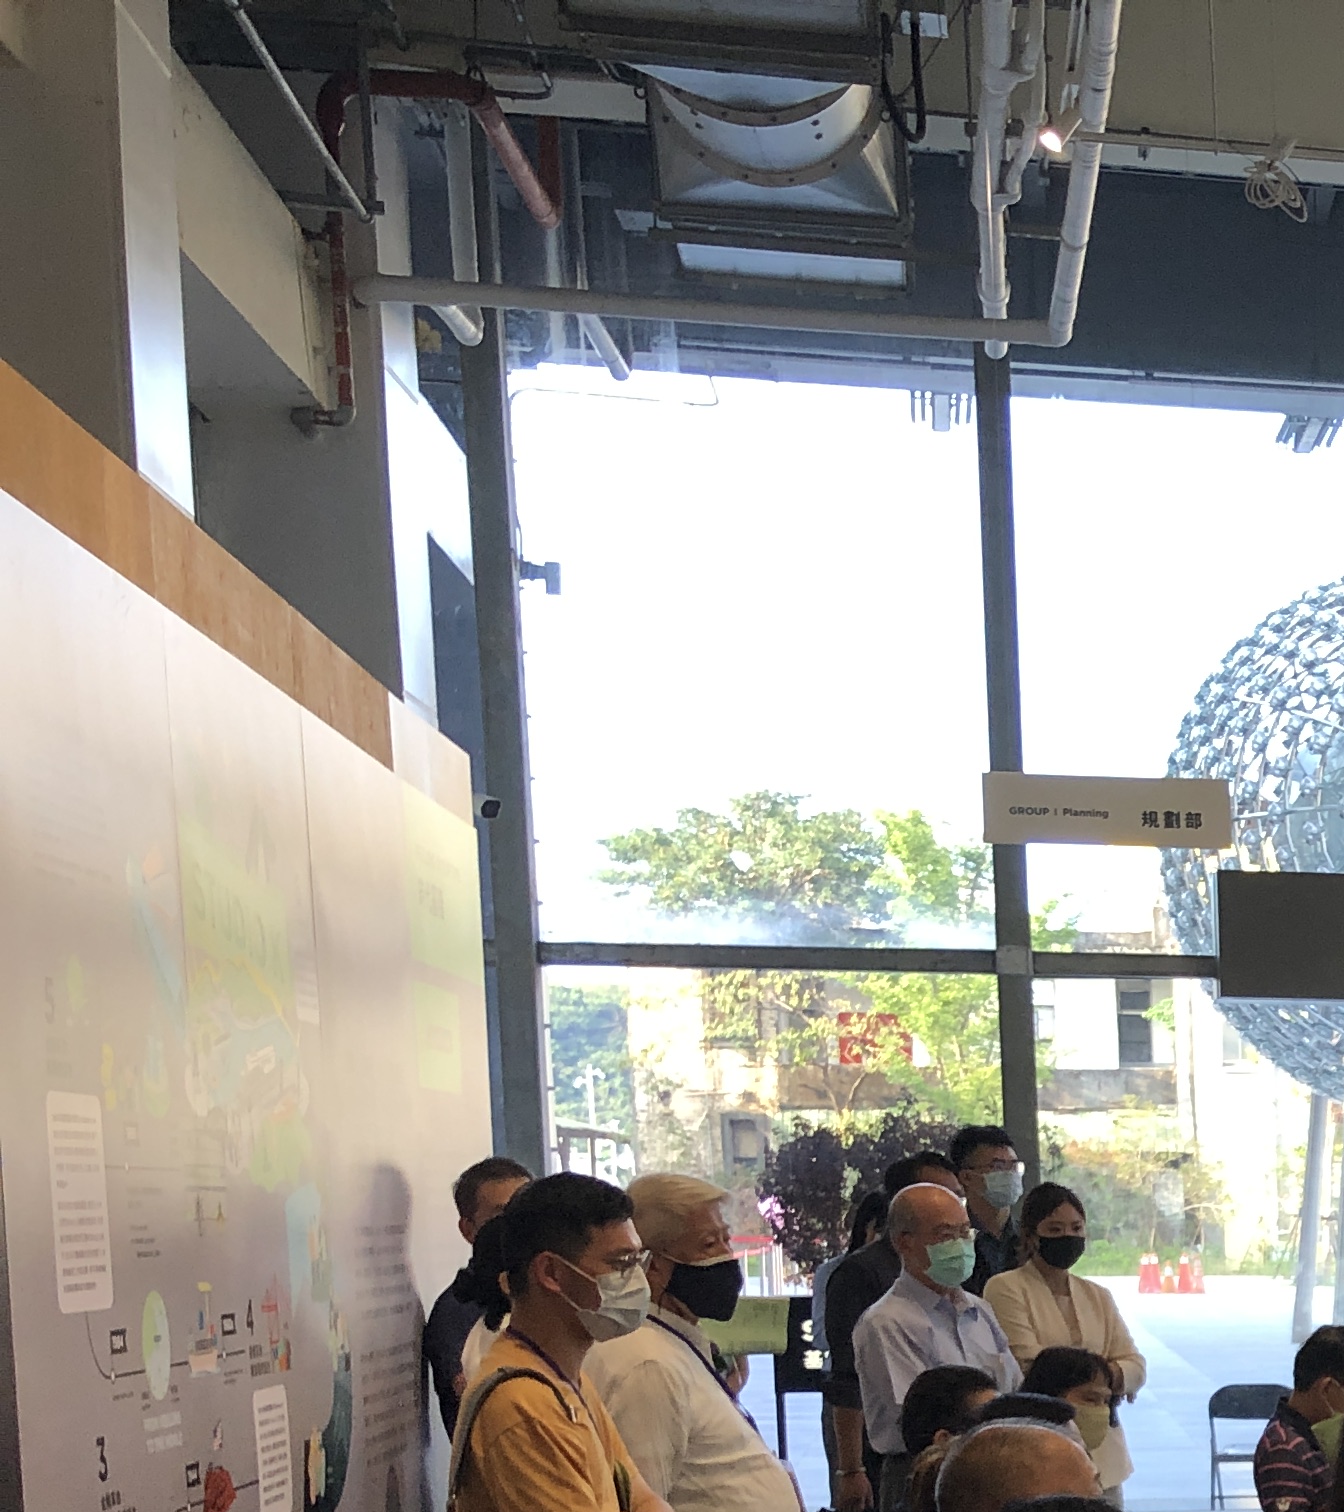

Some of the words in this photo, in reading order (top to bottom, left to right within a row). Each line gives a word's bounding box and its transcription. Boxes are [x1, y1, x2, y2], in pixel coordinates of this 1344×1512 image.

[1009, 805, 1050, 816] GROUP
[1062, 806, 1110, 820] Planning
[1141, 810, 1203, 830] 規劃部
[96, 1436, 108, 1482] 3
